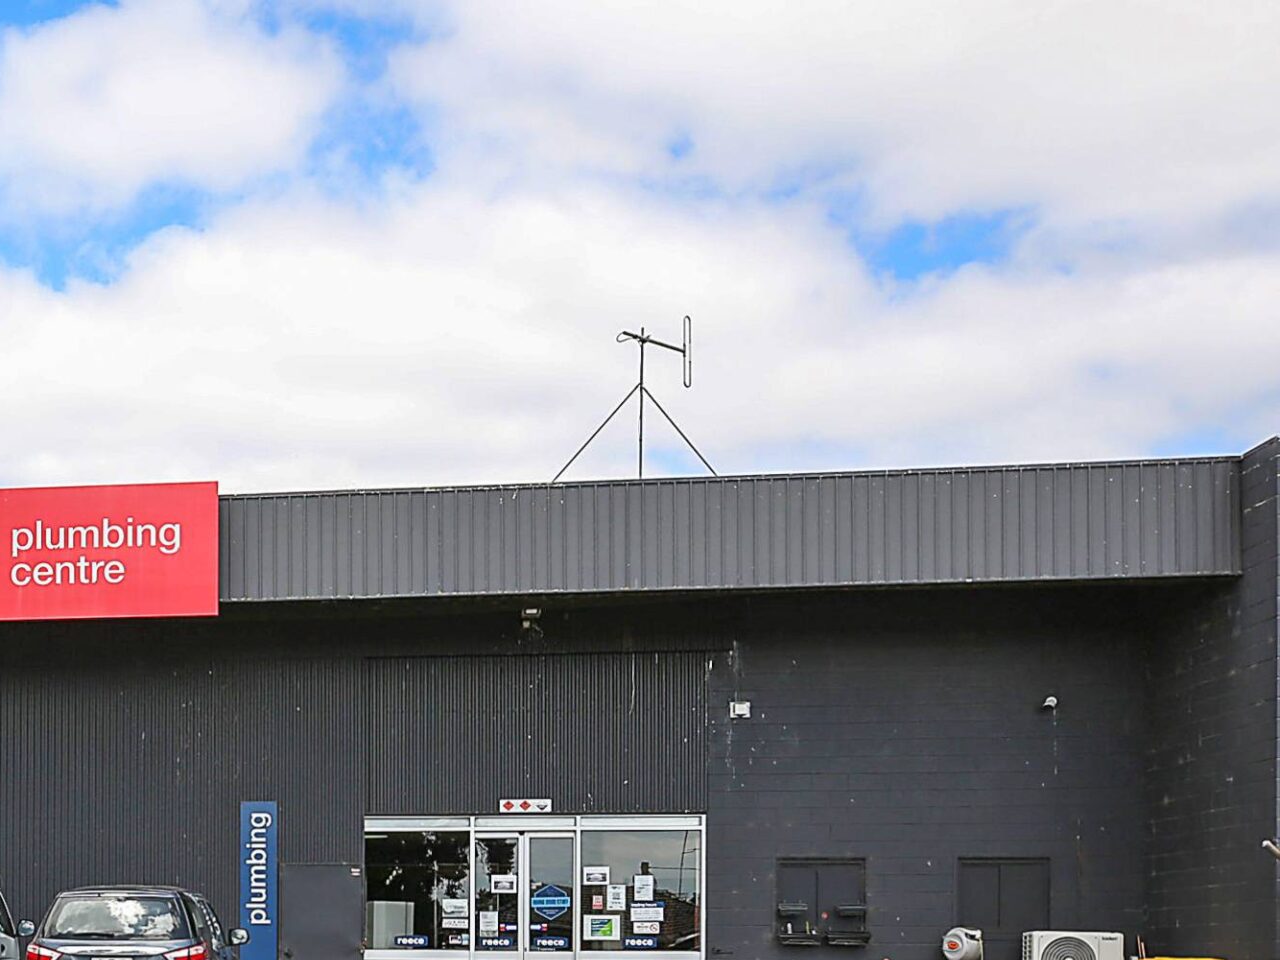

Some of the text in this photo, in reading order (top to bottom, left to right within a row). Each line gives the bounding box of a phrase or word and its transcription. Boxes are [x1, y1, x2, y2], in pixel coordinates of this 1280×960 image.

[10, 517, 181, 557] plumbing
[10, 555, 125, 586] centre
[246, 812, 272, 925] plumbing
[397, 937, 425, 945] reece
